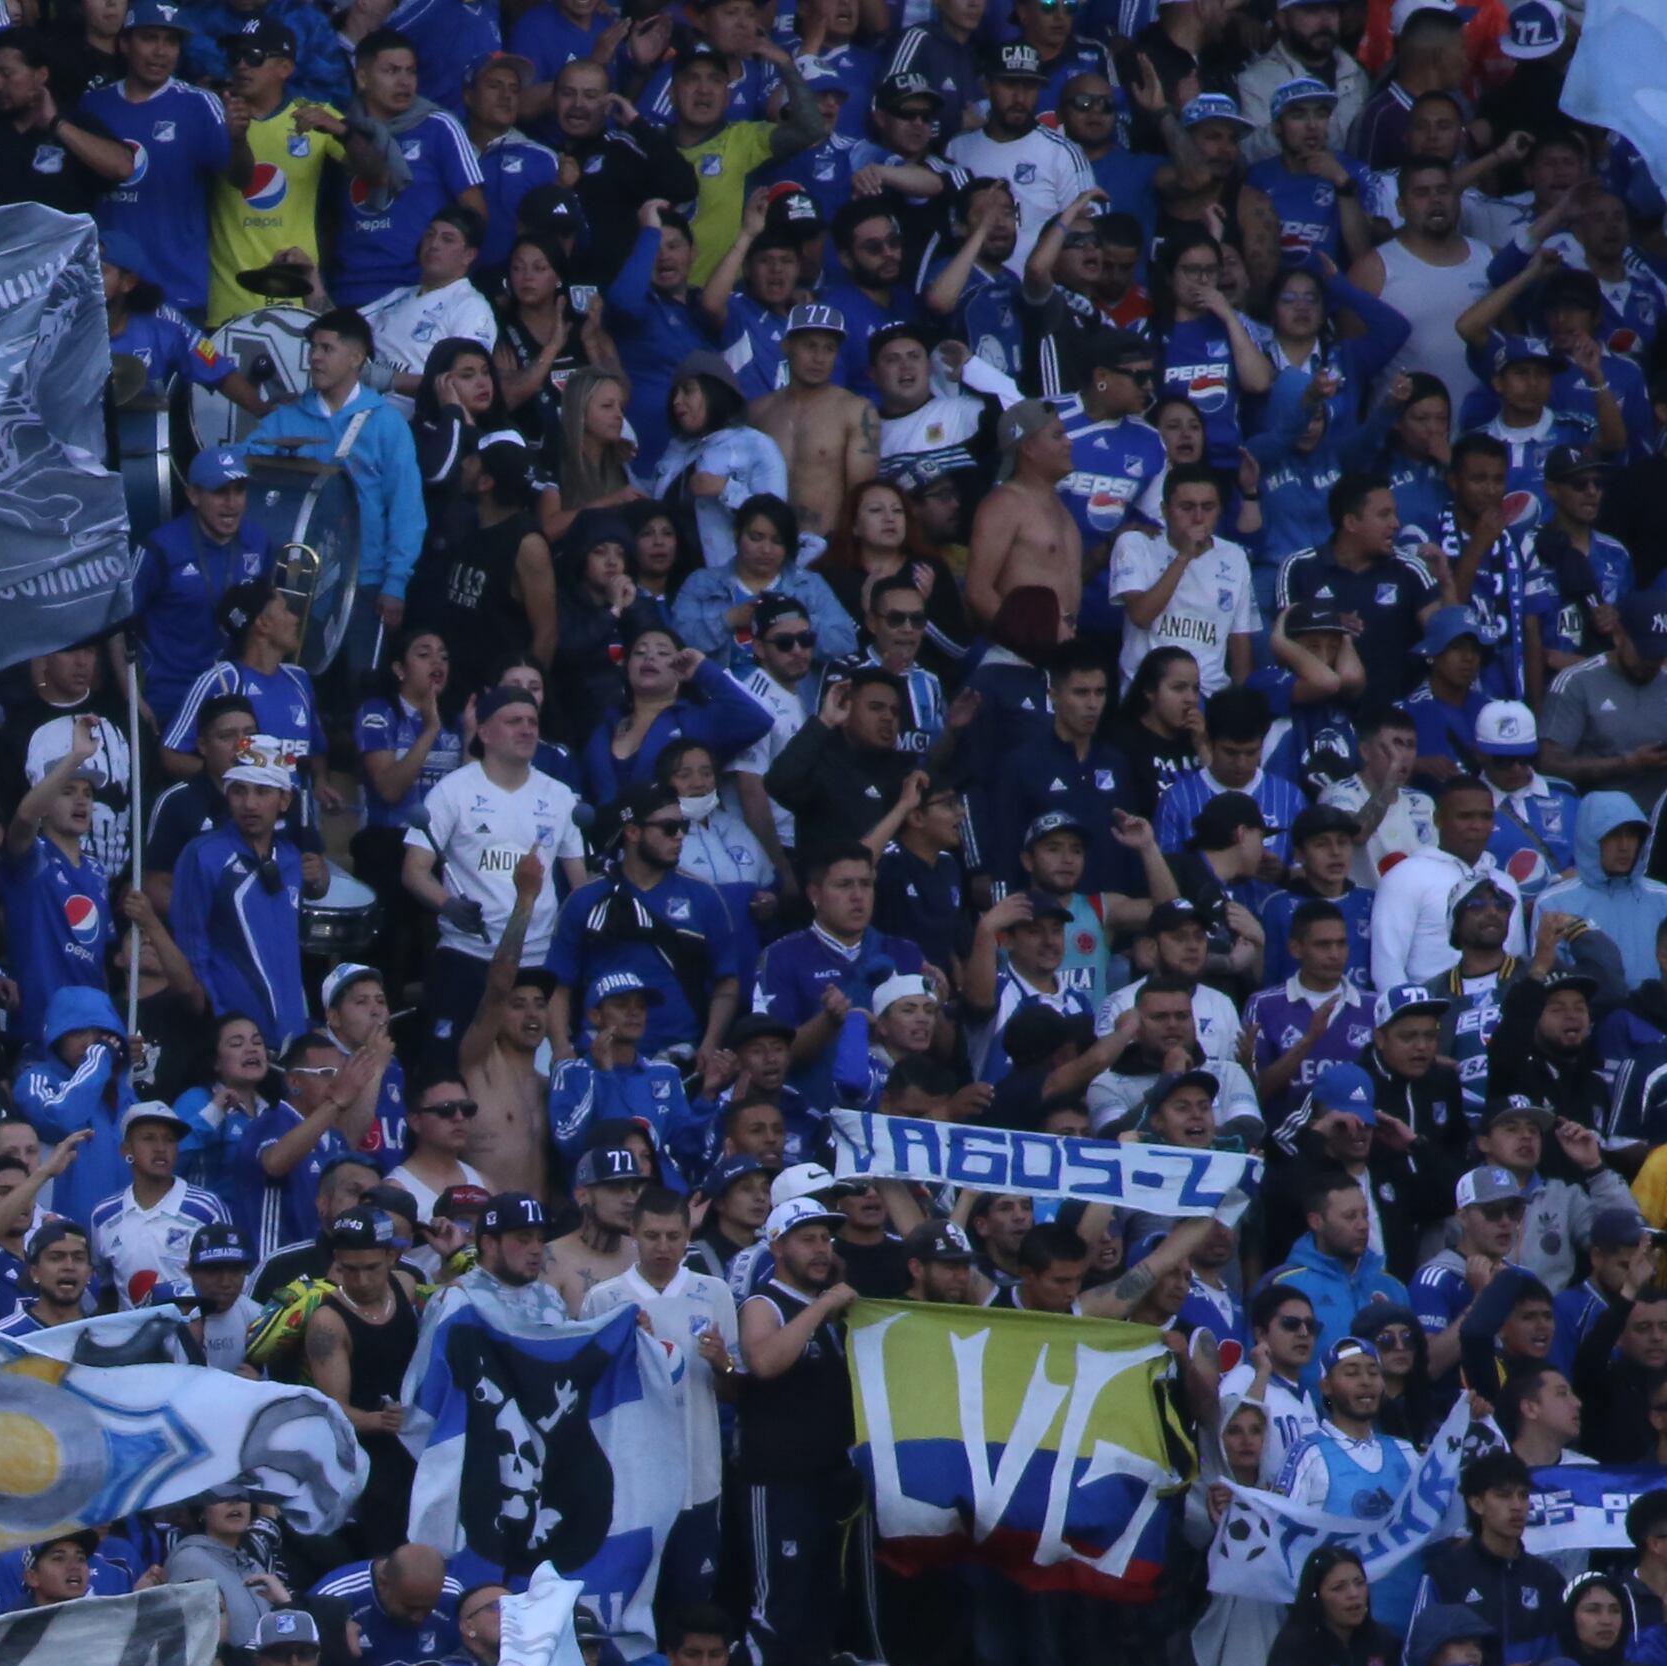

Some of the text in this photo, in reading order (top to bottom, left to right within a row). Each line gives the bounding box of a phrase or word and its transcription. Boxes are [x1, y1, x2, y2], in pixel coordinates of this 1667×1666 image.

[355, 217, 391, 233] pepsi
[1280, 220, 1330, 243] PSI
[804, 304, 831, 324] 77
[1163, 363, 1229, 384] PEPSI
[1157, 613, 1217, 646] ANDINA
[606, 1150, 634, 1173] 77
[519, 1199, 544, 1222] 77
